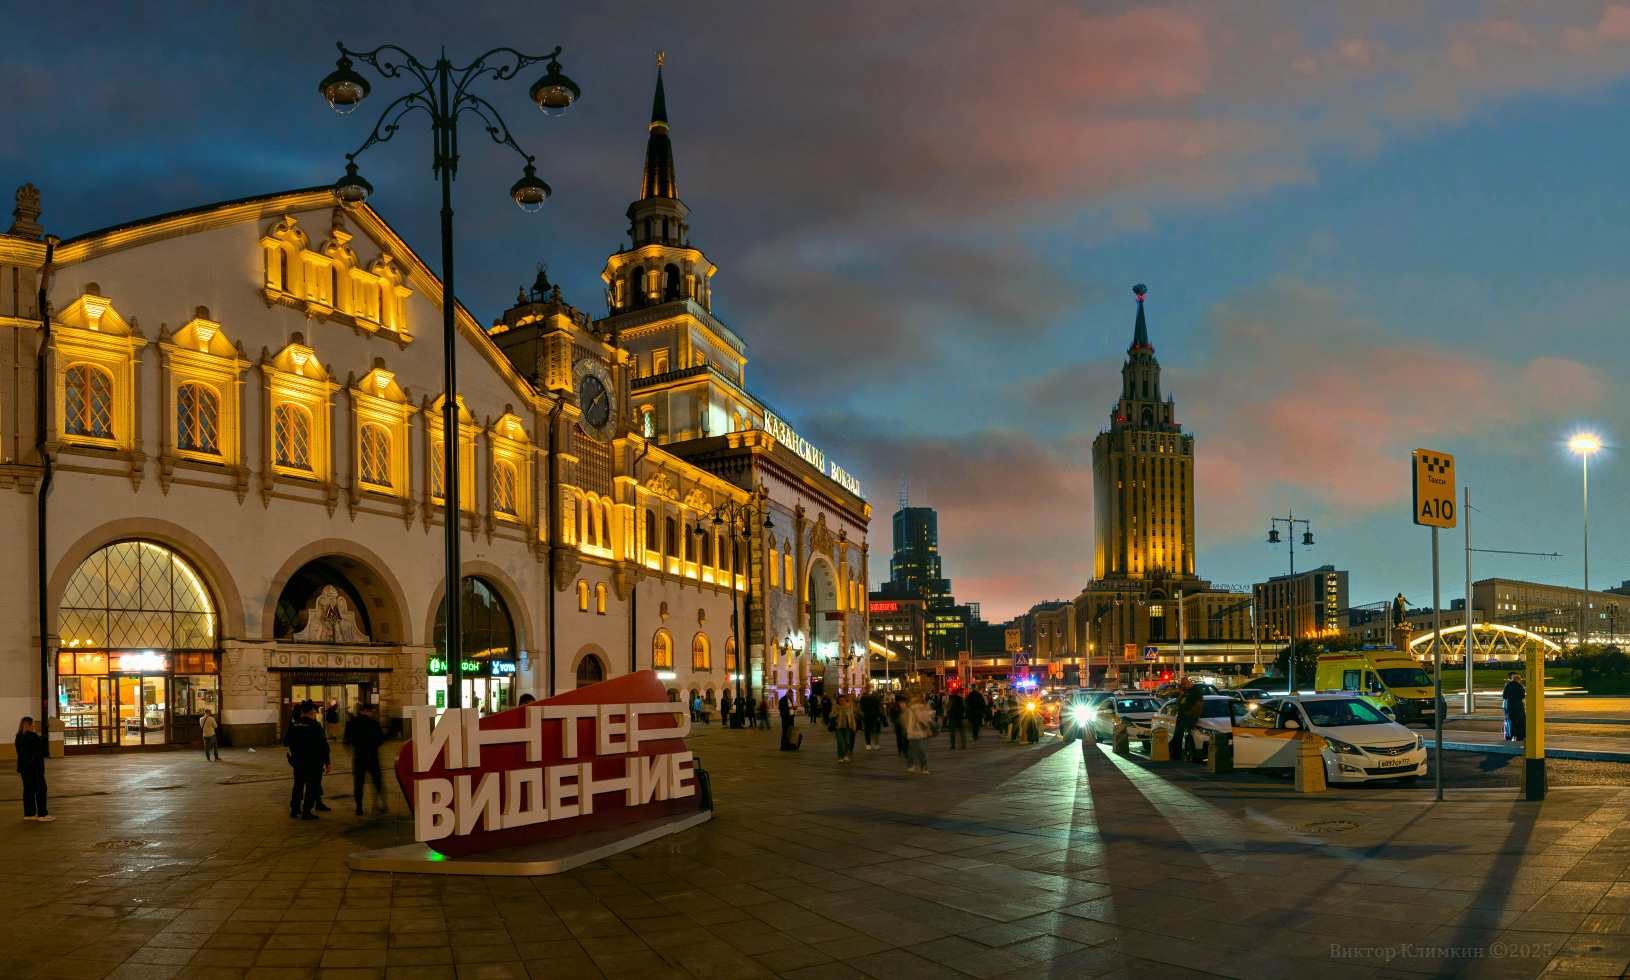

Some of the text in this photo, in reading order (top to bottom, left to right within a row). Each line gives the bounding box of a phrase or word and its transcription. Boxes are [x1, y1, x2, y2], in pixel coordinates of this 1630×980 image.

[763, 409, 860, 497] КАЗАНСКИЙ ВОКЗАЛ
[1427, 475, 1446, 485] Такси
[1421, 498, 1453, 520] А10
[500, 663, 516, 672] YOTA
[403, 701, 691, 773] ИНТЕР
[413, 751, 696, 842] ВИДЕНИЕ
